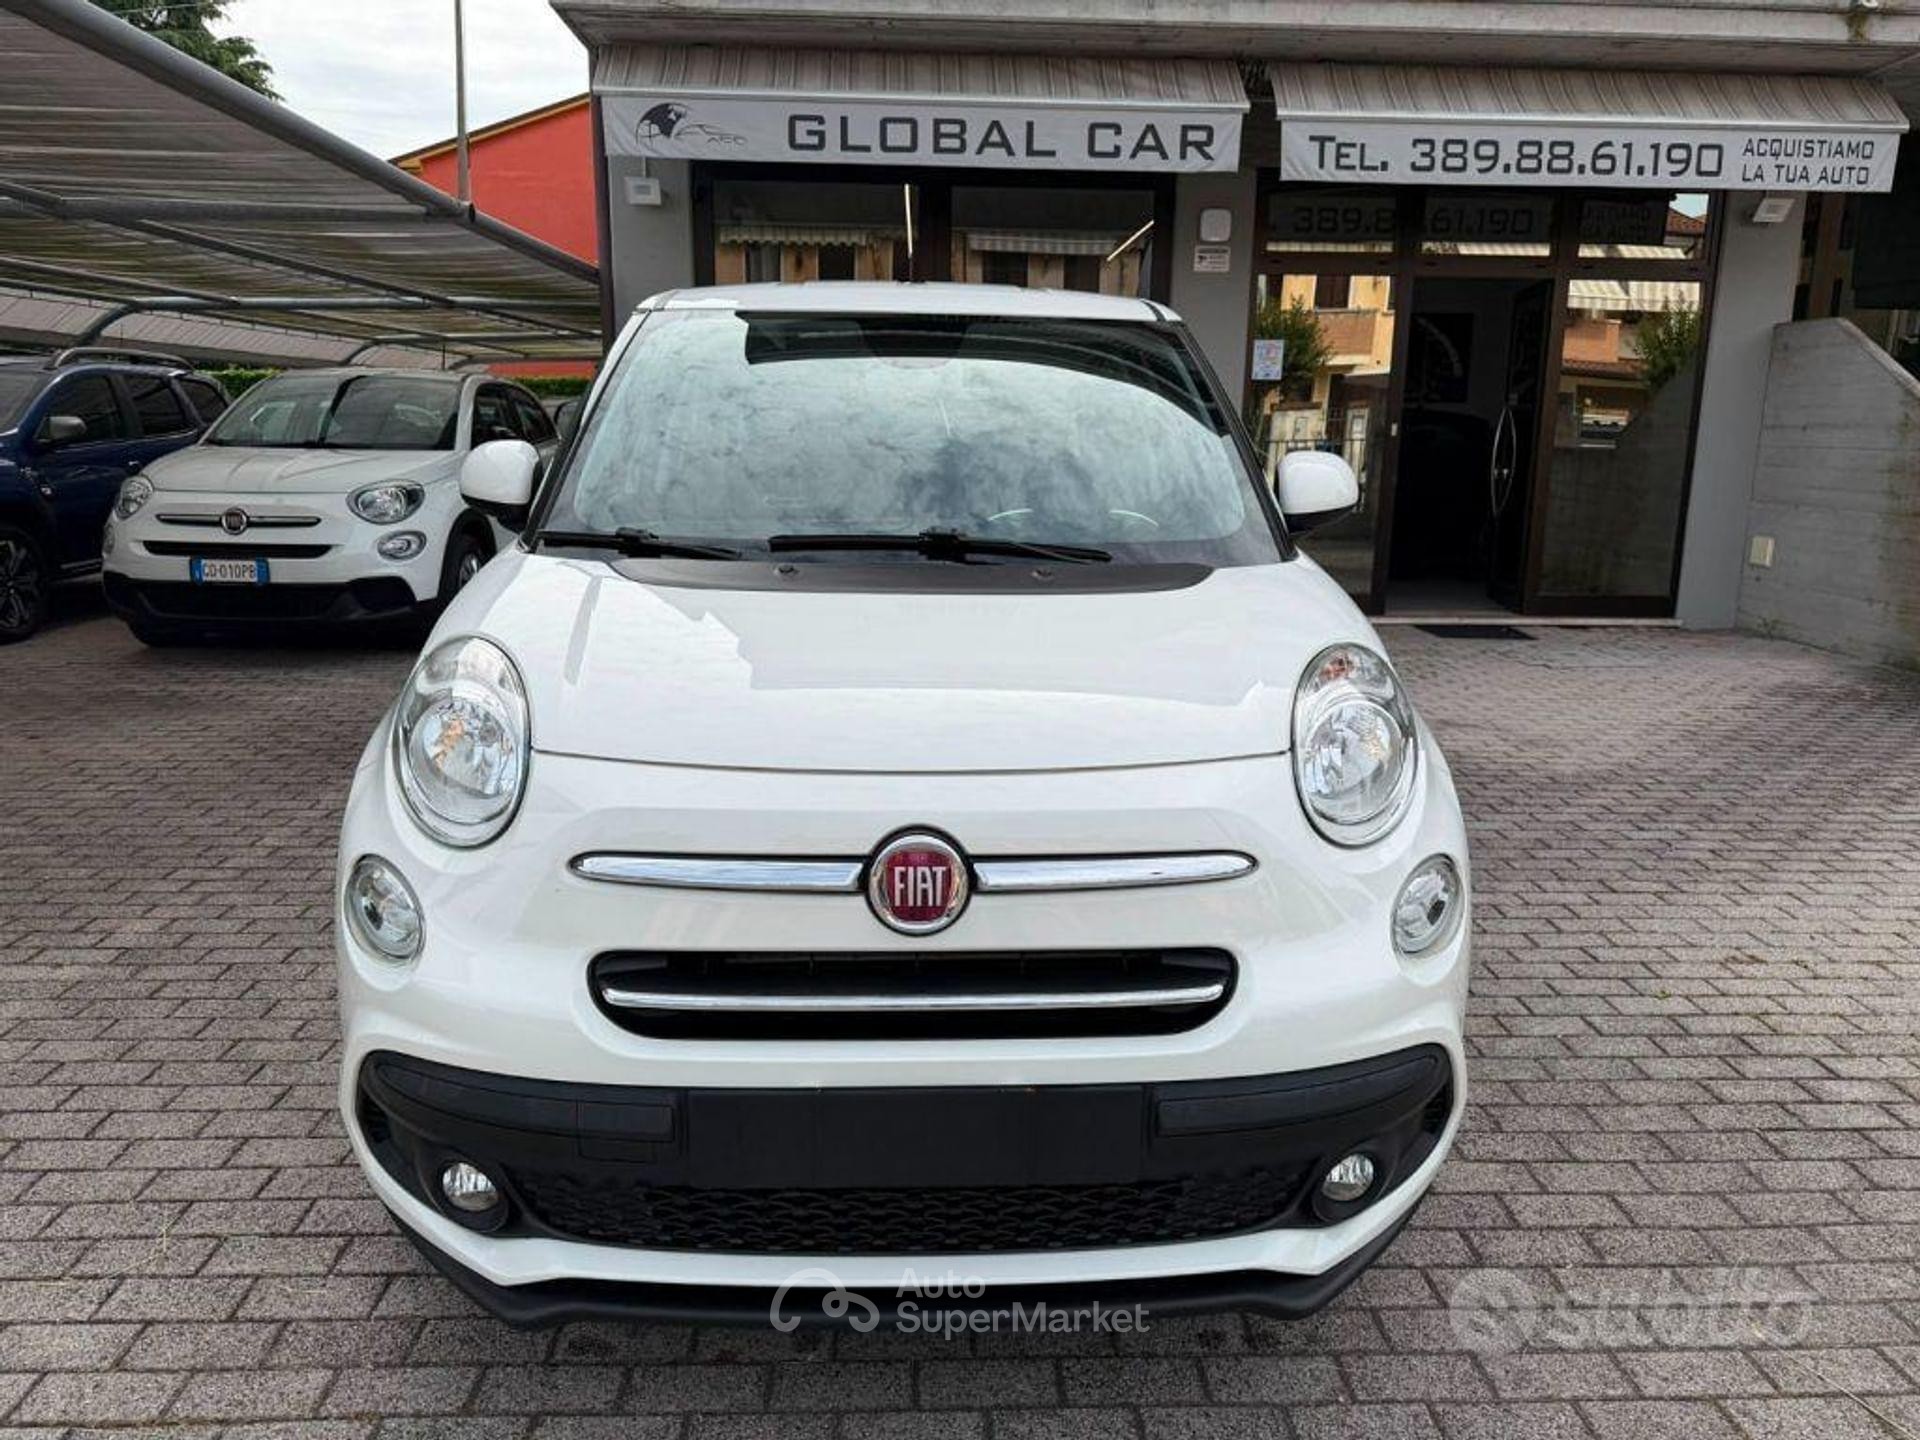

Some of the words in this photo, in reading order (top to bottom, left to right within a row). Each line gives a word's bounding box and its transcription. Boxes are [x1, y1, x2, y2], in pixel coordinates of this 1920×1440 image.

[787, 114, 1057, 157] GLOBAL
[1087, 121, 1215, 161] CAR
[1742, 138, 1875, 160] ACQUISTIAMO
[1410, 138, 1724, 178] 389.88.61.190
[1742, 164, 1765, 182] LA
[1774, 165, 1810, 183] TUA
[1817, 166, 1870, 185] AUTO
[893, 866, 947, 907] FIAT
